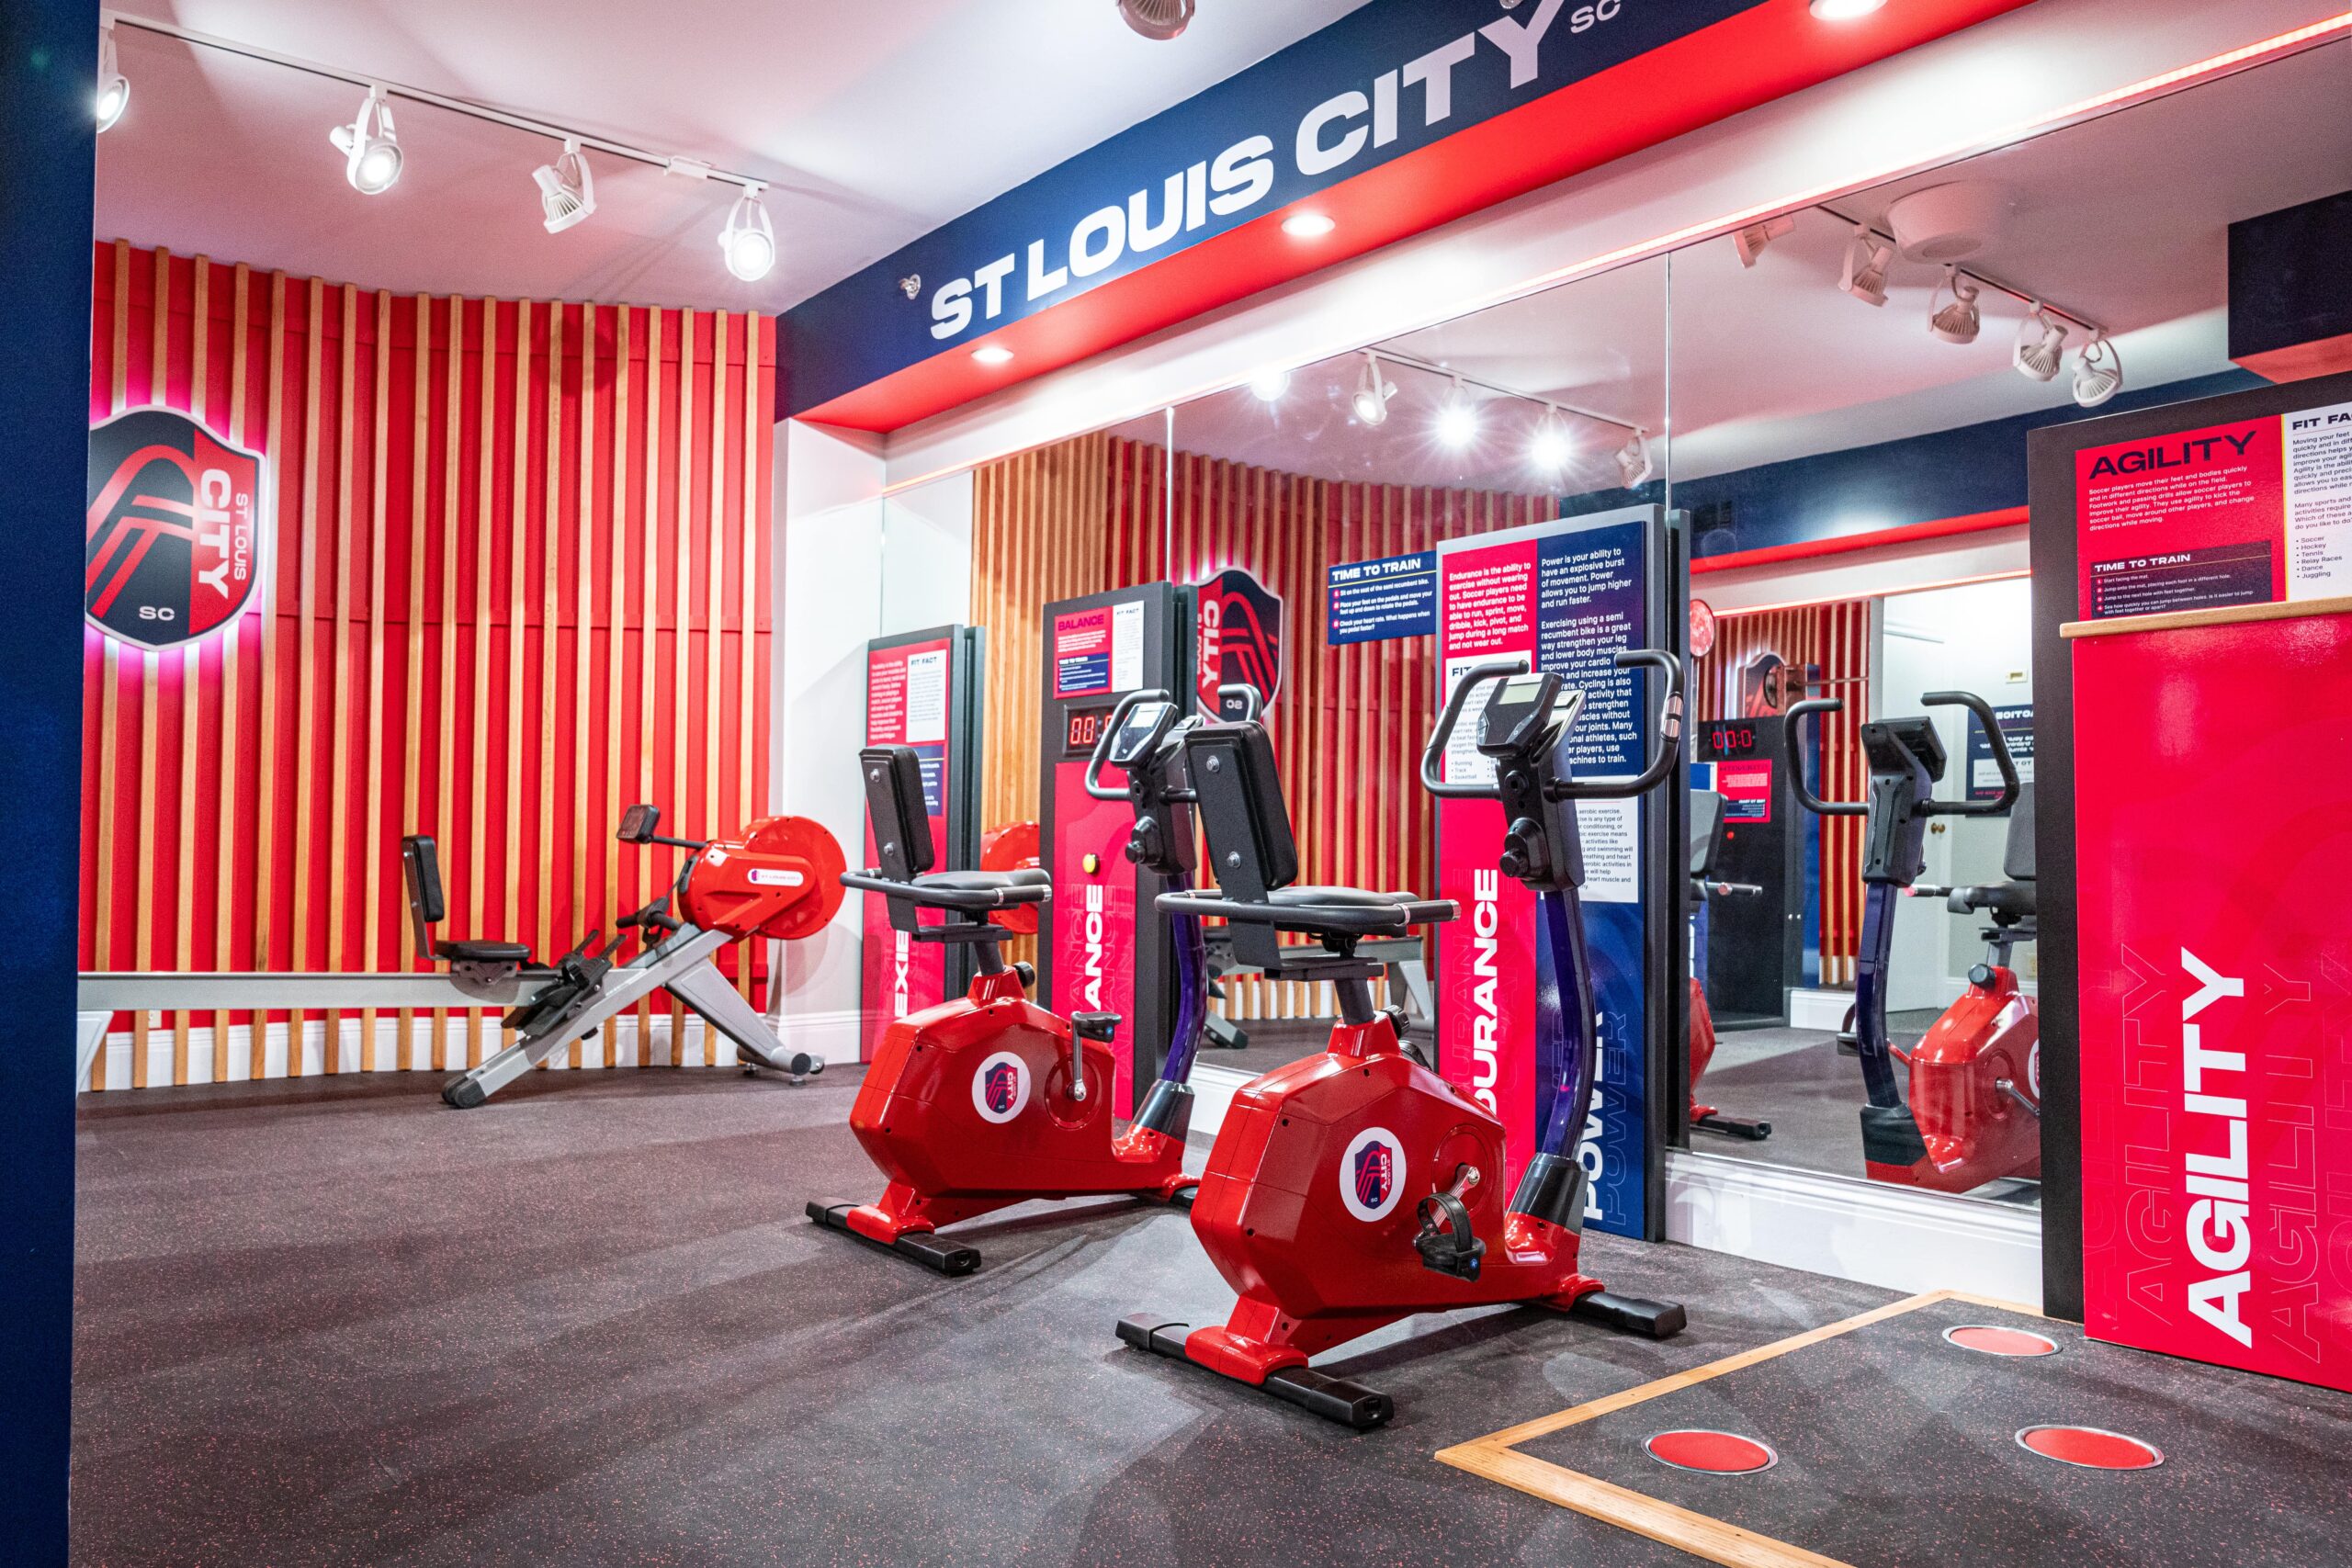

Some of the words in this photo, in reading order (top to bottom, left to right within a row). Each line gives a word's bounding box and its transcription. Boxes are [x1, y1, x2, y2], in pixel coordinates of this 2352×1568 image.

[930, 254, 1014, 340] ST
[1028, 136, 1274, 301] LOUIS
[1296, 0, 1565, 175] CITY
[1570, 0, 1621, 34] SC
[2292, 417, 2321, 430] FIT
[2328, 412, 2352, 424] FA
[2089, 431, 2256, 479] AGILITY
[2222, 466, 2247, 474] quickly
[2109, 491, 2135, 499] different
[2136, 486, 2168, 494] directions
[2132, 495, 2156, 503] passing
[2217, 482, 2242, 491] players
[235, 492, 248, 519] ST
[198, 468, 232, 599] CITY
[234, 525, 248, 581] LOUIS
[1541, 558, 1563, 566] Power
[1564, 555, 1570, 563] is
[1572, 553, 1589, 563] your
[1589, 549, 1611, 558] ability
[1612, 547, 1621, 556] to
[1332, 568, 1361, 581] TIME
[1363, 565, 1380, 576] TO
[1383, 558, 1421, 573] TRAIN
[1541, 569, 1558, 577] have
[1569, 561, 1603, 572] explosive
[1605, 558, 1624, 568] burst
[2095, 562, 2125, 572] TIME
[2129, 559, 2146, 568] TO
[2150, 554, 2190, 566] TRAIN
[1449, 570, 1483, 581] Endurance
[1502, 563, 1522, 572] ability
[1541, 579, 1548, 587] of
[1550, 574, 1589, 585] movement.
[1590, 571, 1613, 580] Power
[1449, 581, 1476, 591] exercise
[1476, 577, 1500, 586] without
[1501, 573, 1528, 582] wearing
[1462, 590, 1485, 599] Soccer
[1485, 586, 1509, 596] players
[1510, 582, 1527, 592] need
[1541, 589, 1563, 597] allows
[1564, 587, 1577, 596] you
[1588, 583, 1606, 592] jump
[1608, 580, 1632, 590] higher
[1472, 597, 1507, 607] endurance
[1541, 599, 1554, 608] and
[1568, 596, 1591, 604] faster.
[139, 605, 175, 621] SC
[1449, 612, 1463, 620] able
[1509, 614, 1521, 623] and
[1541, 618, 1577, 628] Exercising
[1577, 615, 1598, 625] using
[1605, 612, 1623, 621] semi
[1057, 614, 1104, 631] BALANCE
[1541, 628, 1578, 639] recumbent
[1580, 626, 1595, 635] bike
[1597, 625, 1603, 633] is
[1611, 623, 1631, 633] great
[1448, 632, 1464, 641] jump
[1464, 629, 1486, 637] during
[1491, 627, 1507, 636] long
[1507, 624, 1528, 632] match
[1448, 641, 1461, 649] and
[1541, 642, 1555, 650] way
[1556, 638, 1595, 648] strengthen
[1597, 636, 1613, 646] your
[1615, 634, 1626, 643] leg
[1084, 885, 1103, 1011] ANCE
[1473, 869, 1498, 1116] DURANCE
[2181, 946, 2252, 1348] AGILITY
